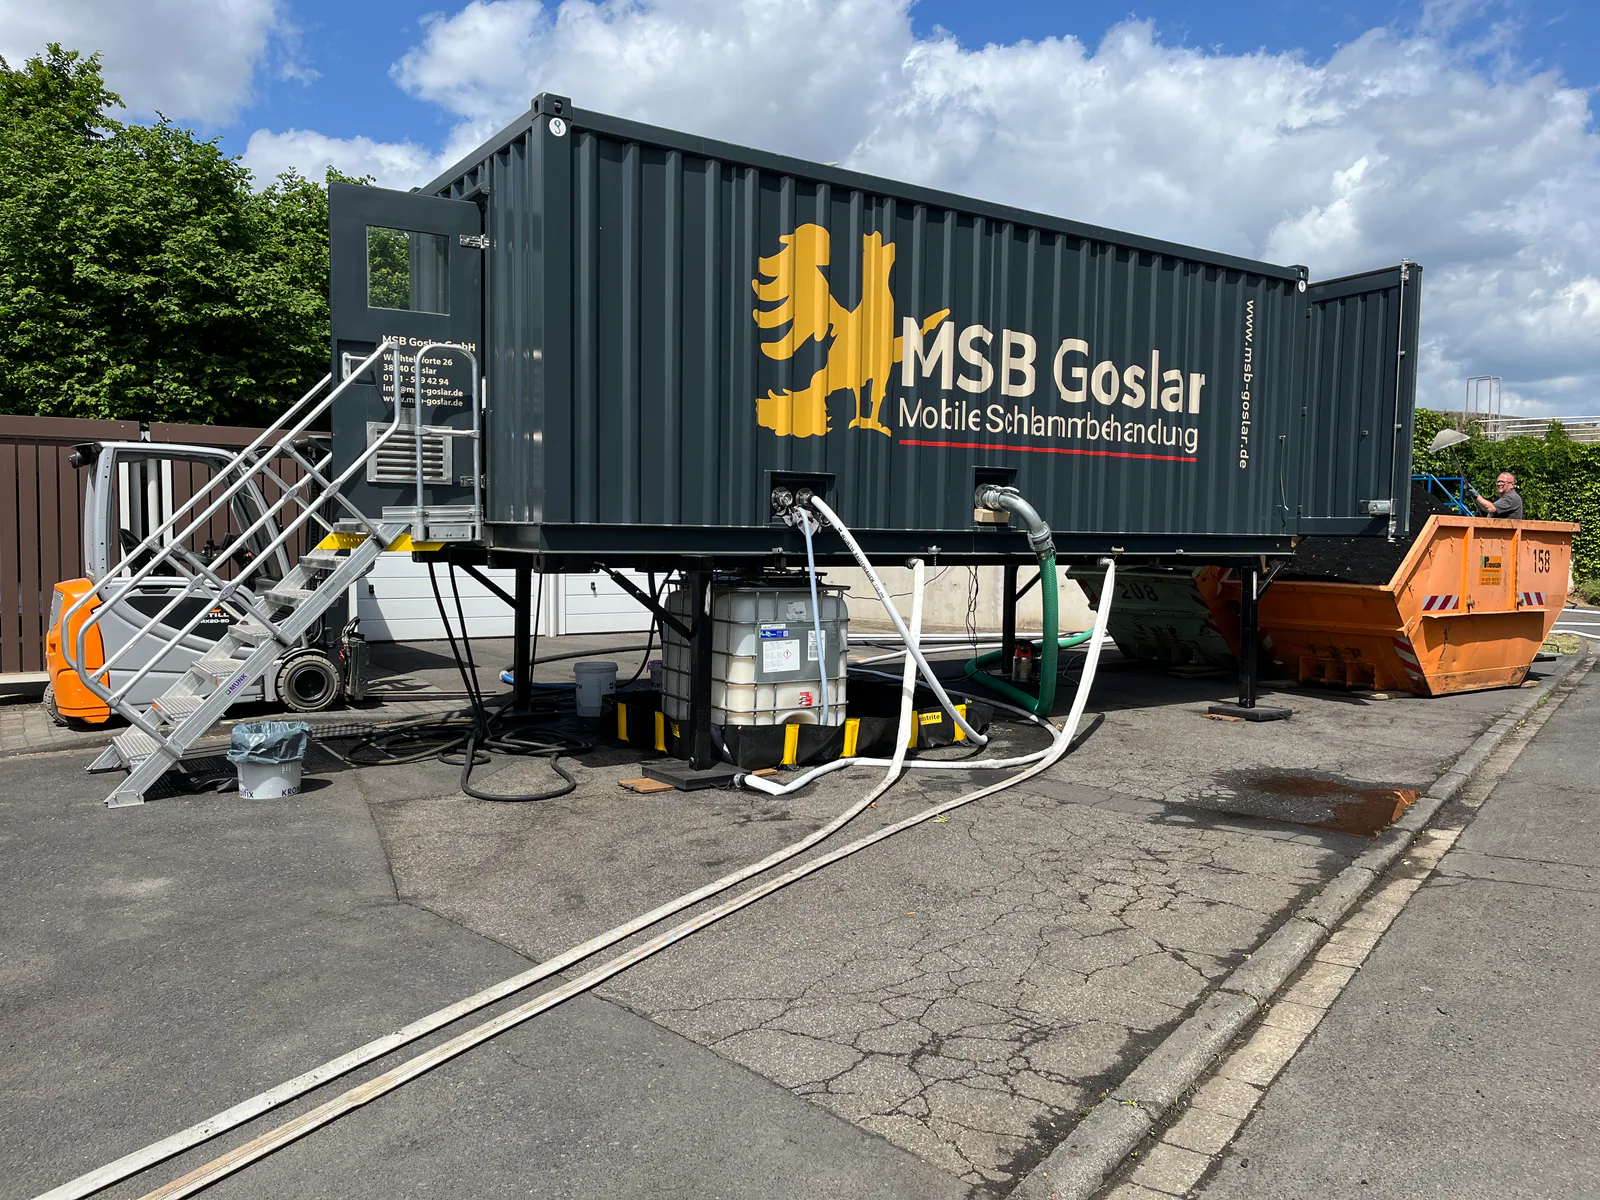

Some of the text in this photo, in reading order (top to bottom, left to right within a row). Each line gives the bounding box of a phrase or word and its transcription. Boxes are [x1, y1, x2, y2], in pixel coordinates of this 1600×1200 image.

[382, 335, 406, 346] MSB
[383, 354, 441, 365] Whtelforte
[902, 316, 1206, 414] MSB Goslar
[383, 364, 437, 375] 3840 Gslar
[383, 374, 403, 383] 011
[410, 376, 426, 384] 59
[427, 377, 437, 385] 42
[438, 378, 449, 386] 94
[1239, 300, 1254, 469] www.msb-goslar.de
[383, 384, 463, 397] inf@m-goslar.de
[383, 396, 463, 407] ww.m-goslar.de
[899, 398, 1199, 454] Mobile Schlammbehandung
[1533, 549, 1551, 574] 158
[1116, 582, 1159, 602] 208
[230, 673, 248, 693] MUNK
[920, 713, 941, 722] strite
